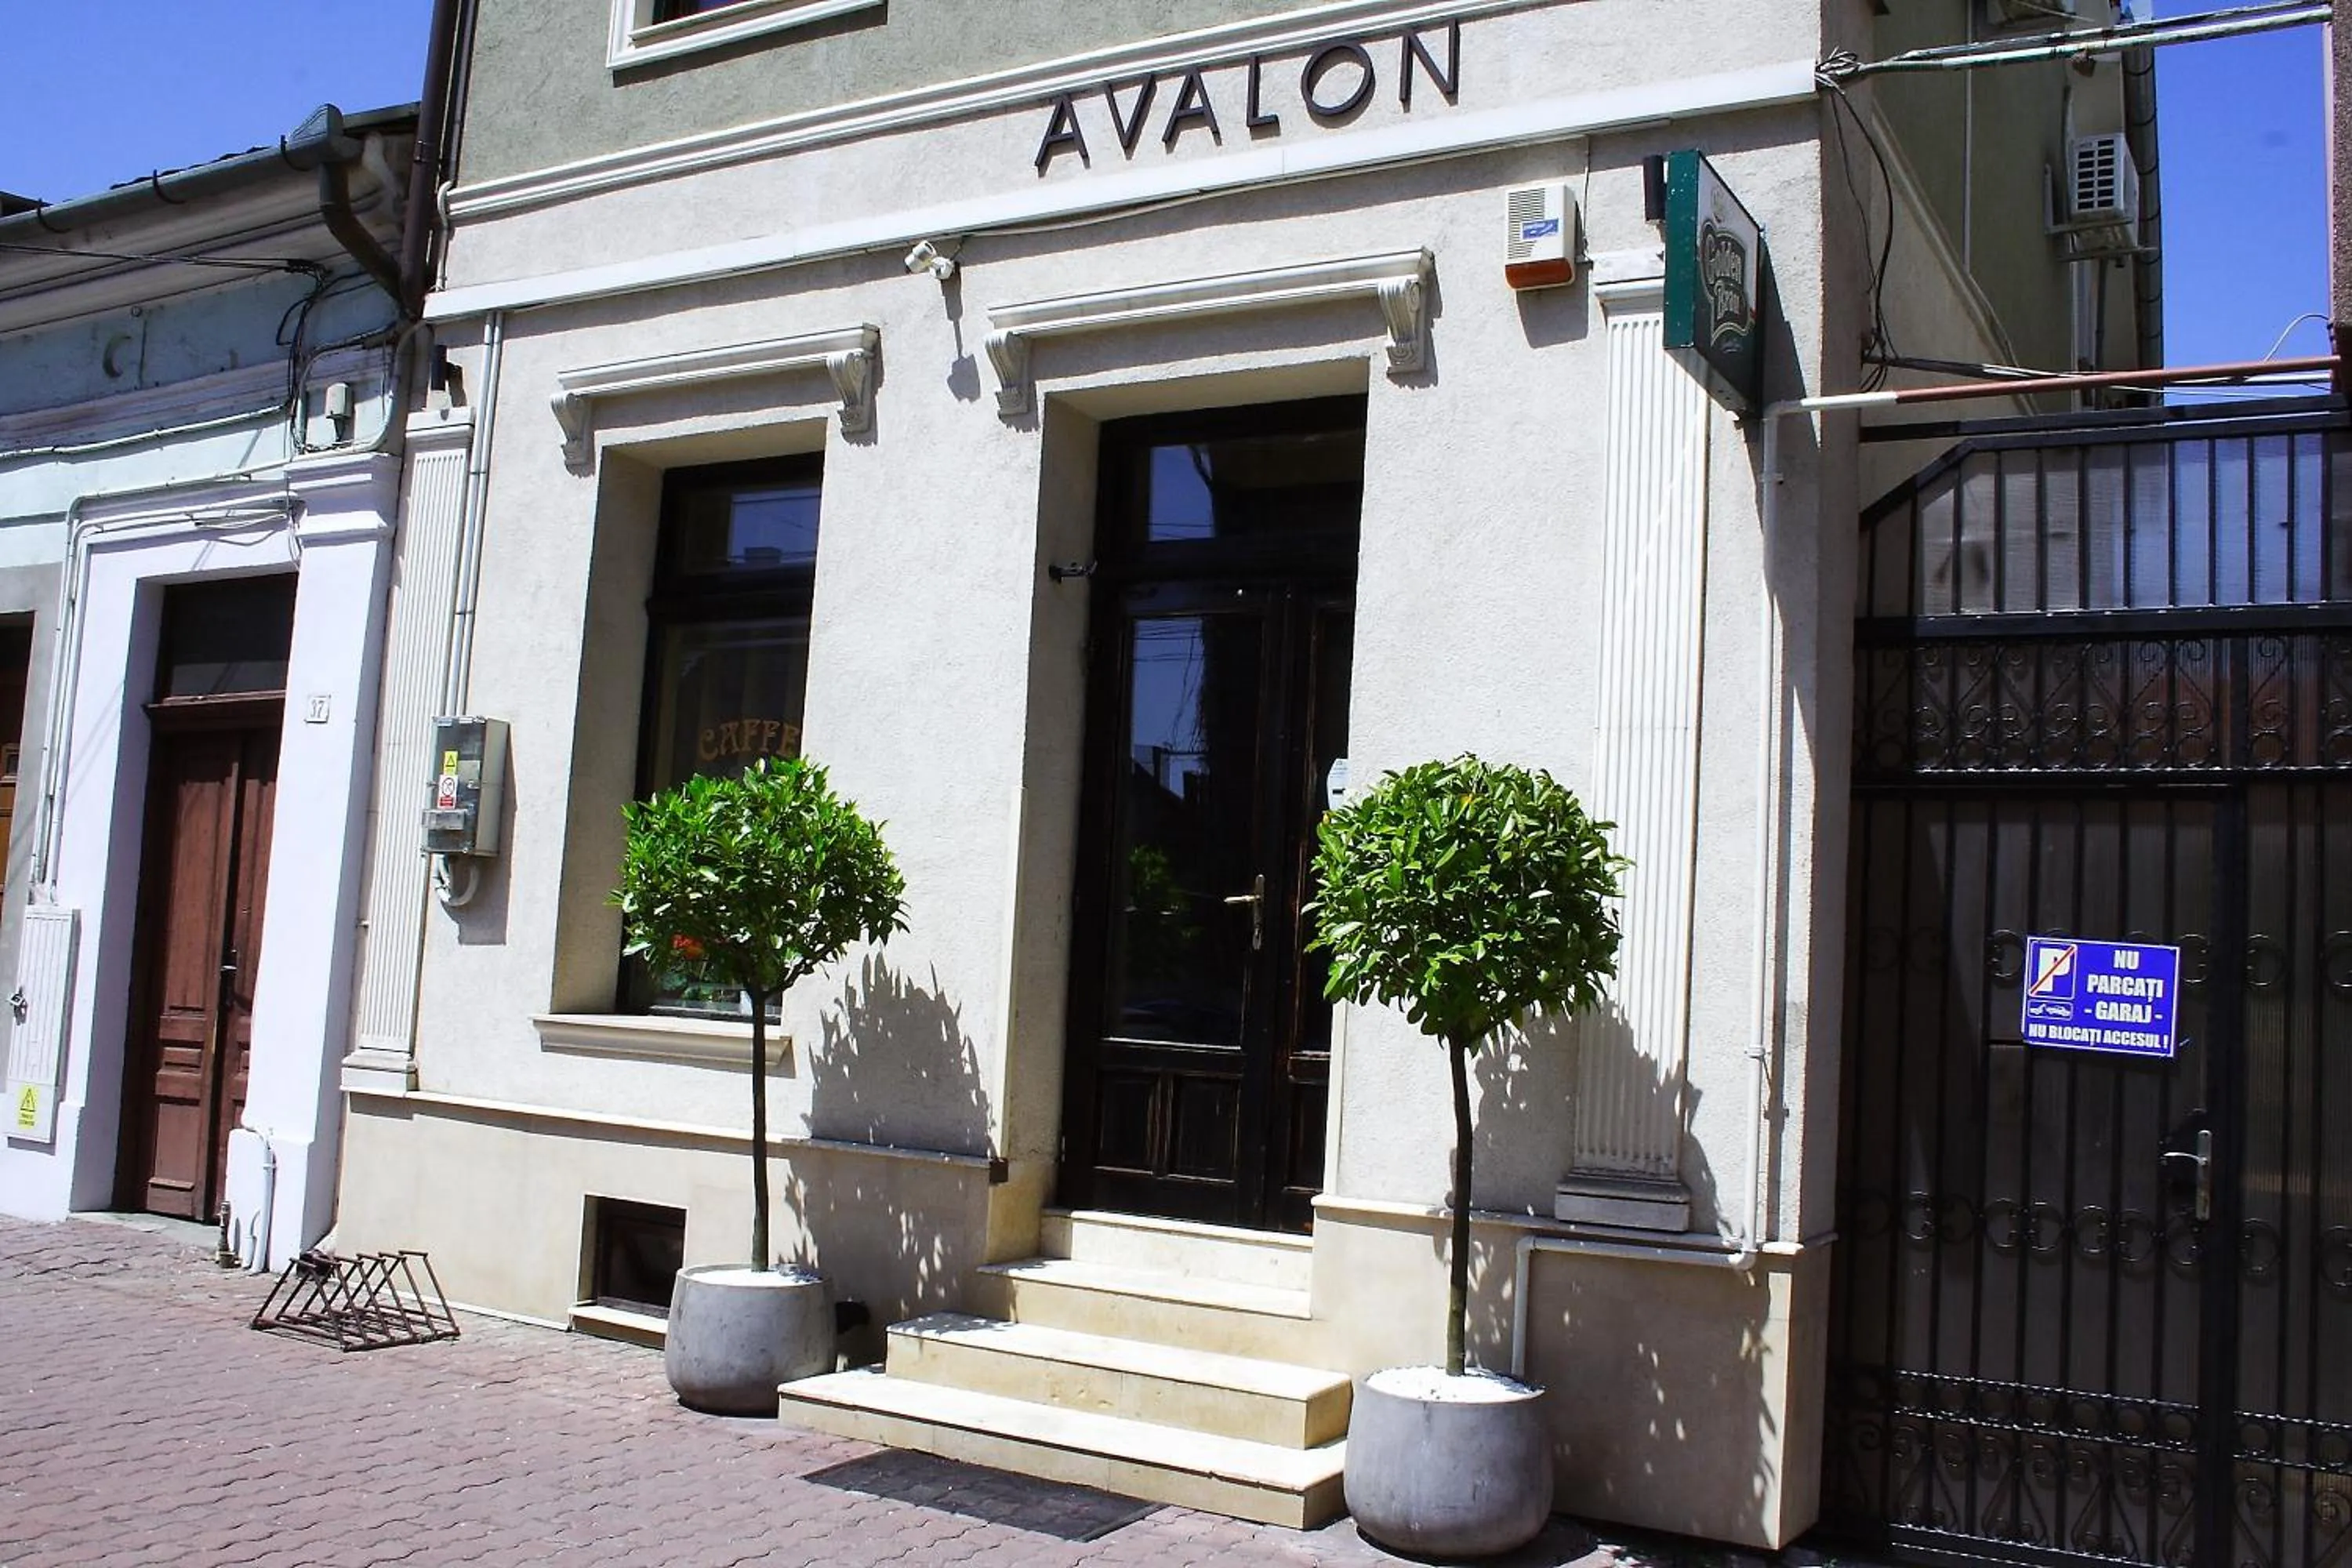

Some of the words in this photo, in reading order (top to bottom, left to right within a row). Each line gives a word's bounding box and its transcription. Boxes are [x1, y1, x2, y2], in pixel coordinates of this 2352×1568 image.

[1034, 19, 1460, 174] AVALON
[2114, 949, 2140, 970] NU
[2086, 974, 2164, 1002] PARCAȚI
[2095, 1000, 2152, 1023] GARAJ
[2028, 1023, 2047, 1039] NU
[2103, 1030, 2161, 1048] ACCESUL
